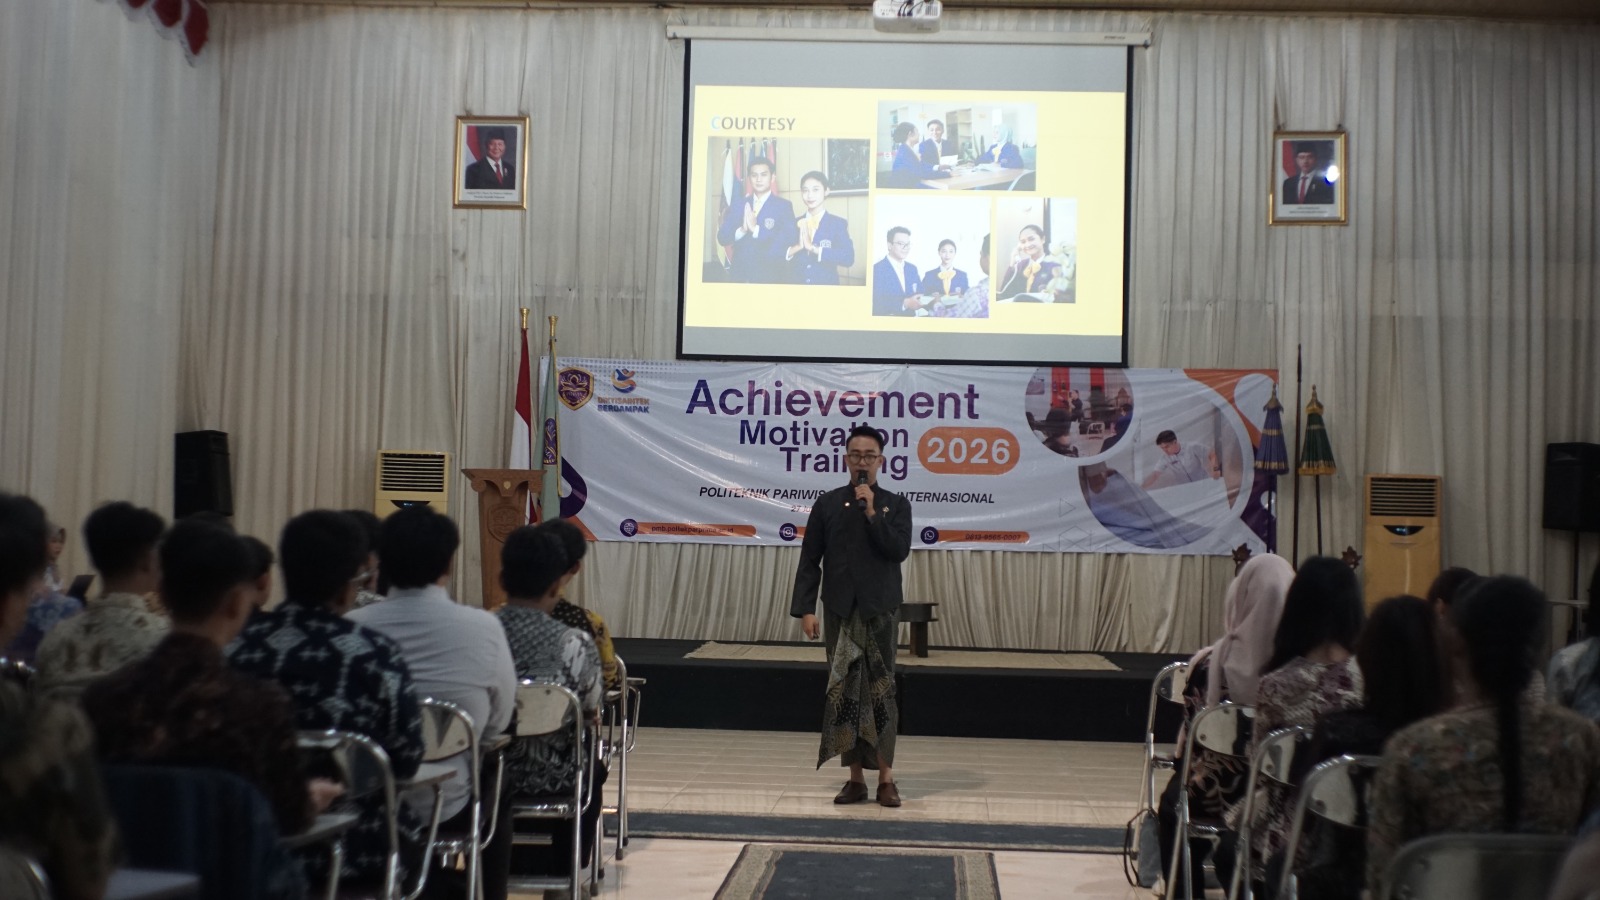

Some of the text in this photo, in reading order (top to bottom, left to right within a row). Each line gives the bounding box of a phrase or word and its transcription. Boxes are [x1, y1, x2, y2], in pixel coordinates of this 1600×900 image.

[711, 116, 796, 131] COURTESY
[686, 379, 979, 420] Achievement
[739, 419, 909, 448] Motivaon
[779, 446, 908, 481] Traig
[927, 437, 1010, 464] 2026
[699, 486, 770, 499] POLITEKNIK
